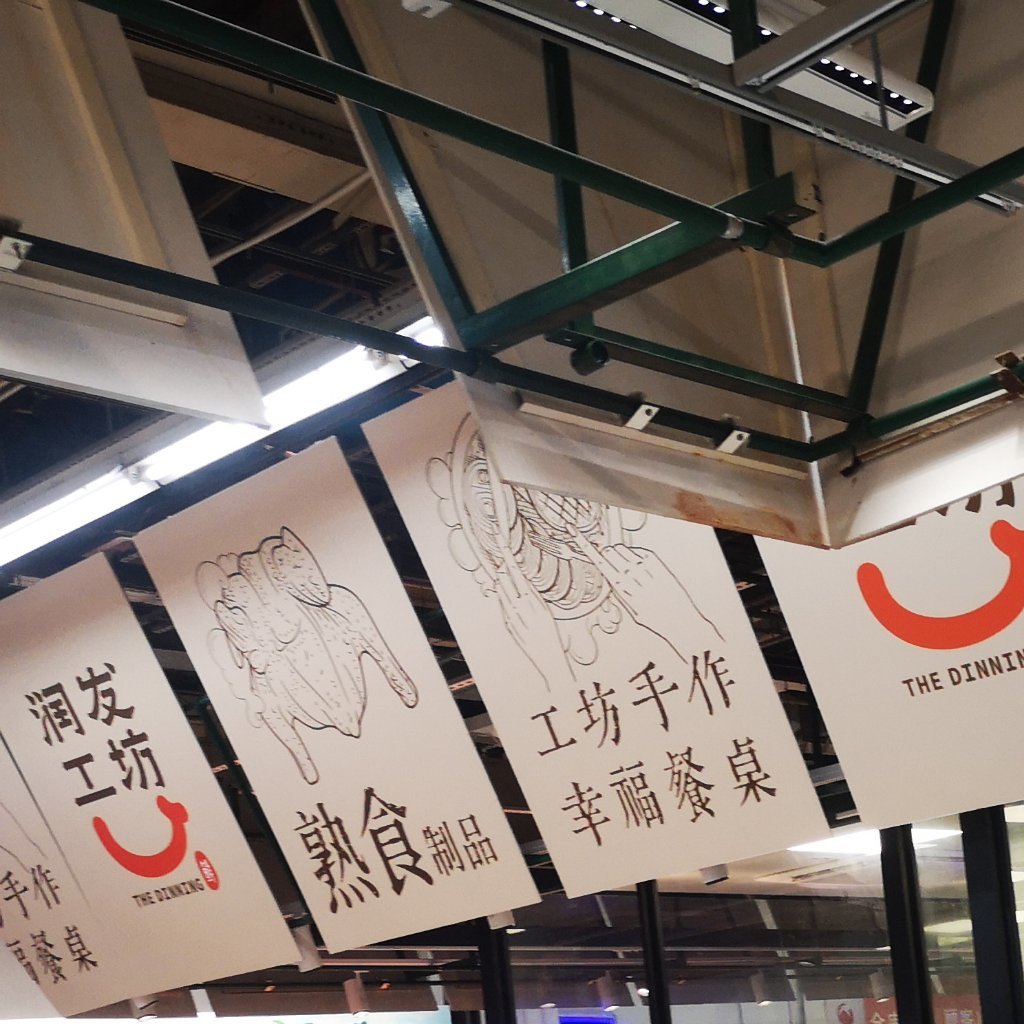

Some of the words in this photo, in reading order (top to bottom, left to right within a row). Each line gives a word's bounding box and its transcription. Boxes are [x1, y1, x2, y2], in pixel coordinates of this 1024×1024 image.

[24, 662, 136, 746] 润发
[530, 650, 736, 757] 工坊手作
[902, 672, 944, 697] THE
[62, 728, 166, 807] 工坊
[561, 736, 777, 846] 幸福餐桌
[294, 786, 498, 914] 熟食制品
[0, 864, 61, 928] 手作
